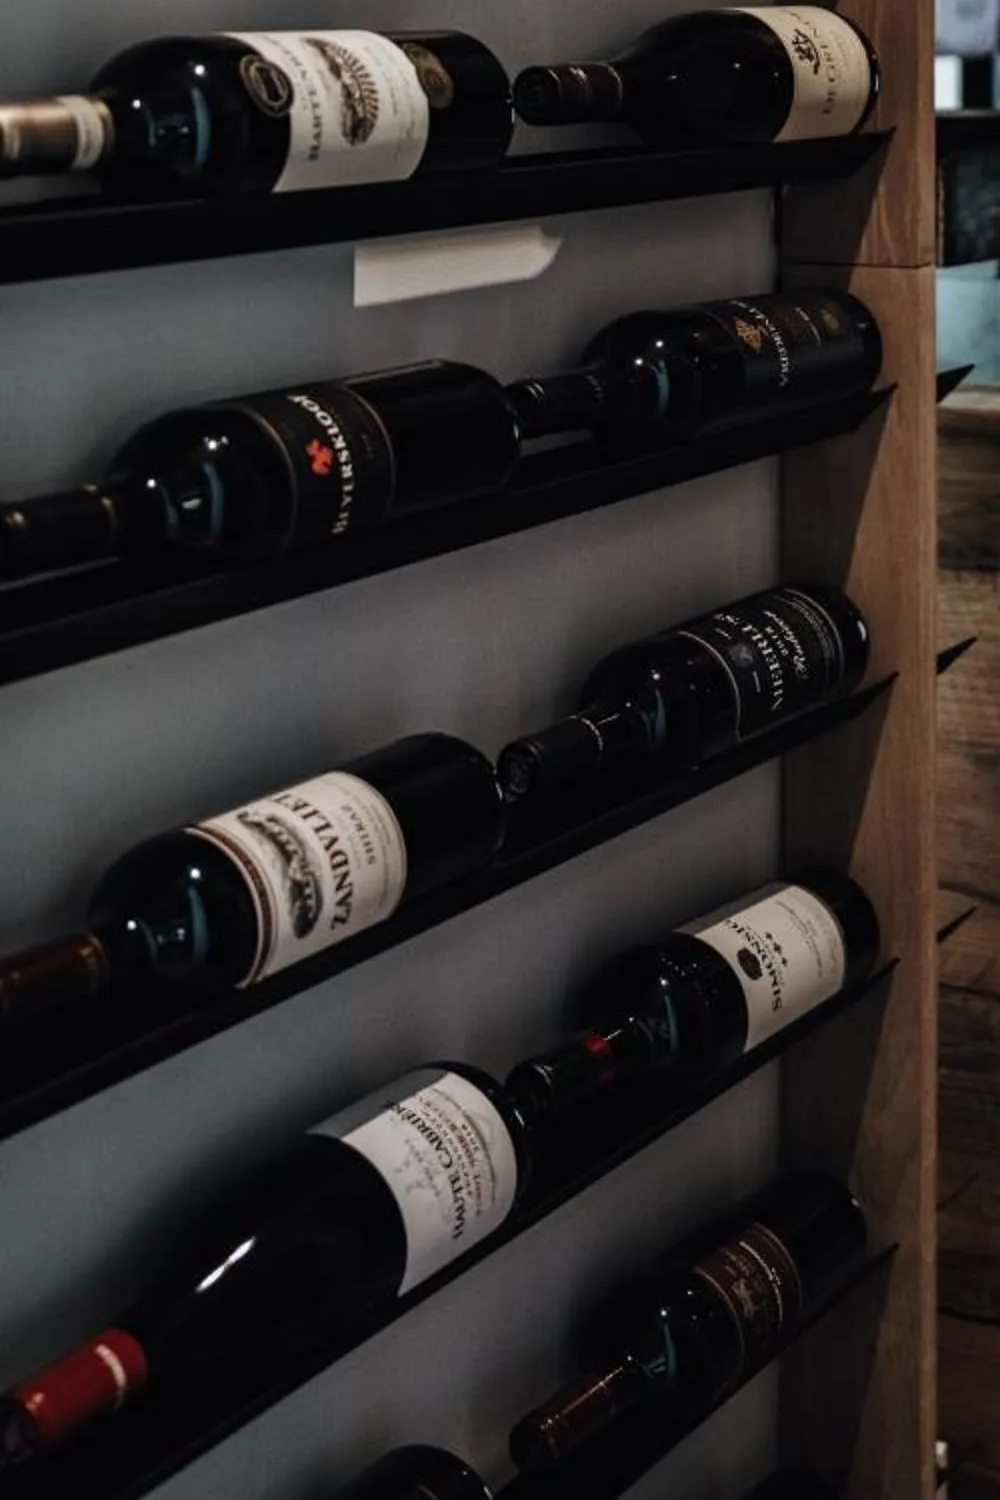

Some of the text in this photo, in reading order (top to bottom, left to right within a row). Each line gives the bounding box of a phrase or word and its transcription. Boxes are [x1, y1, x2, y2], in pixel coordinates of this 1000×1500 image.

[274, 793, 355, 931] ZANDVLIET
[340, 804, 377, 866] SHIRAZ
[448, 1170, 468, 1241] HAUTE
